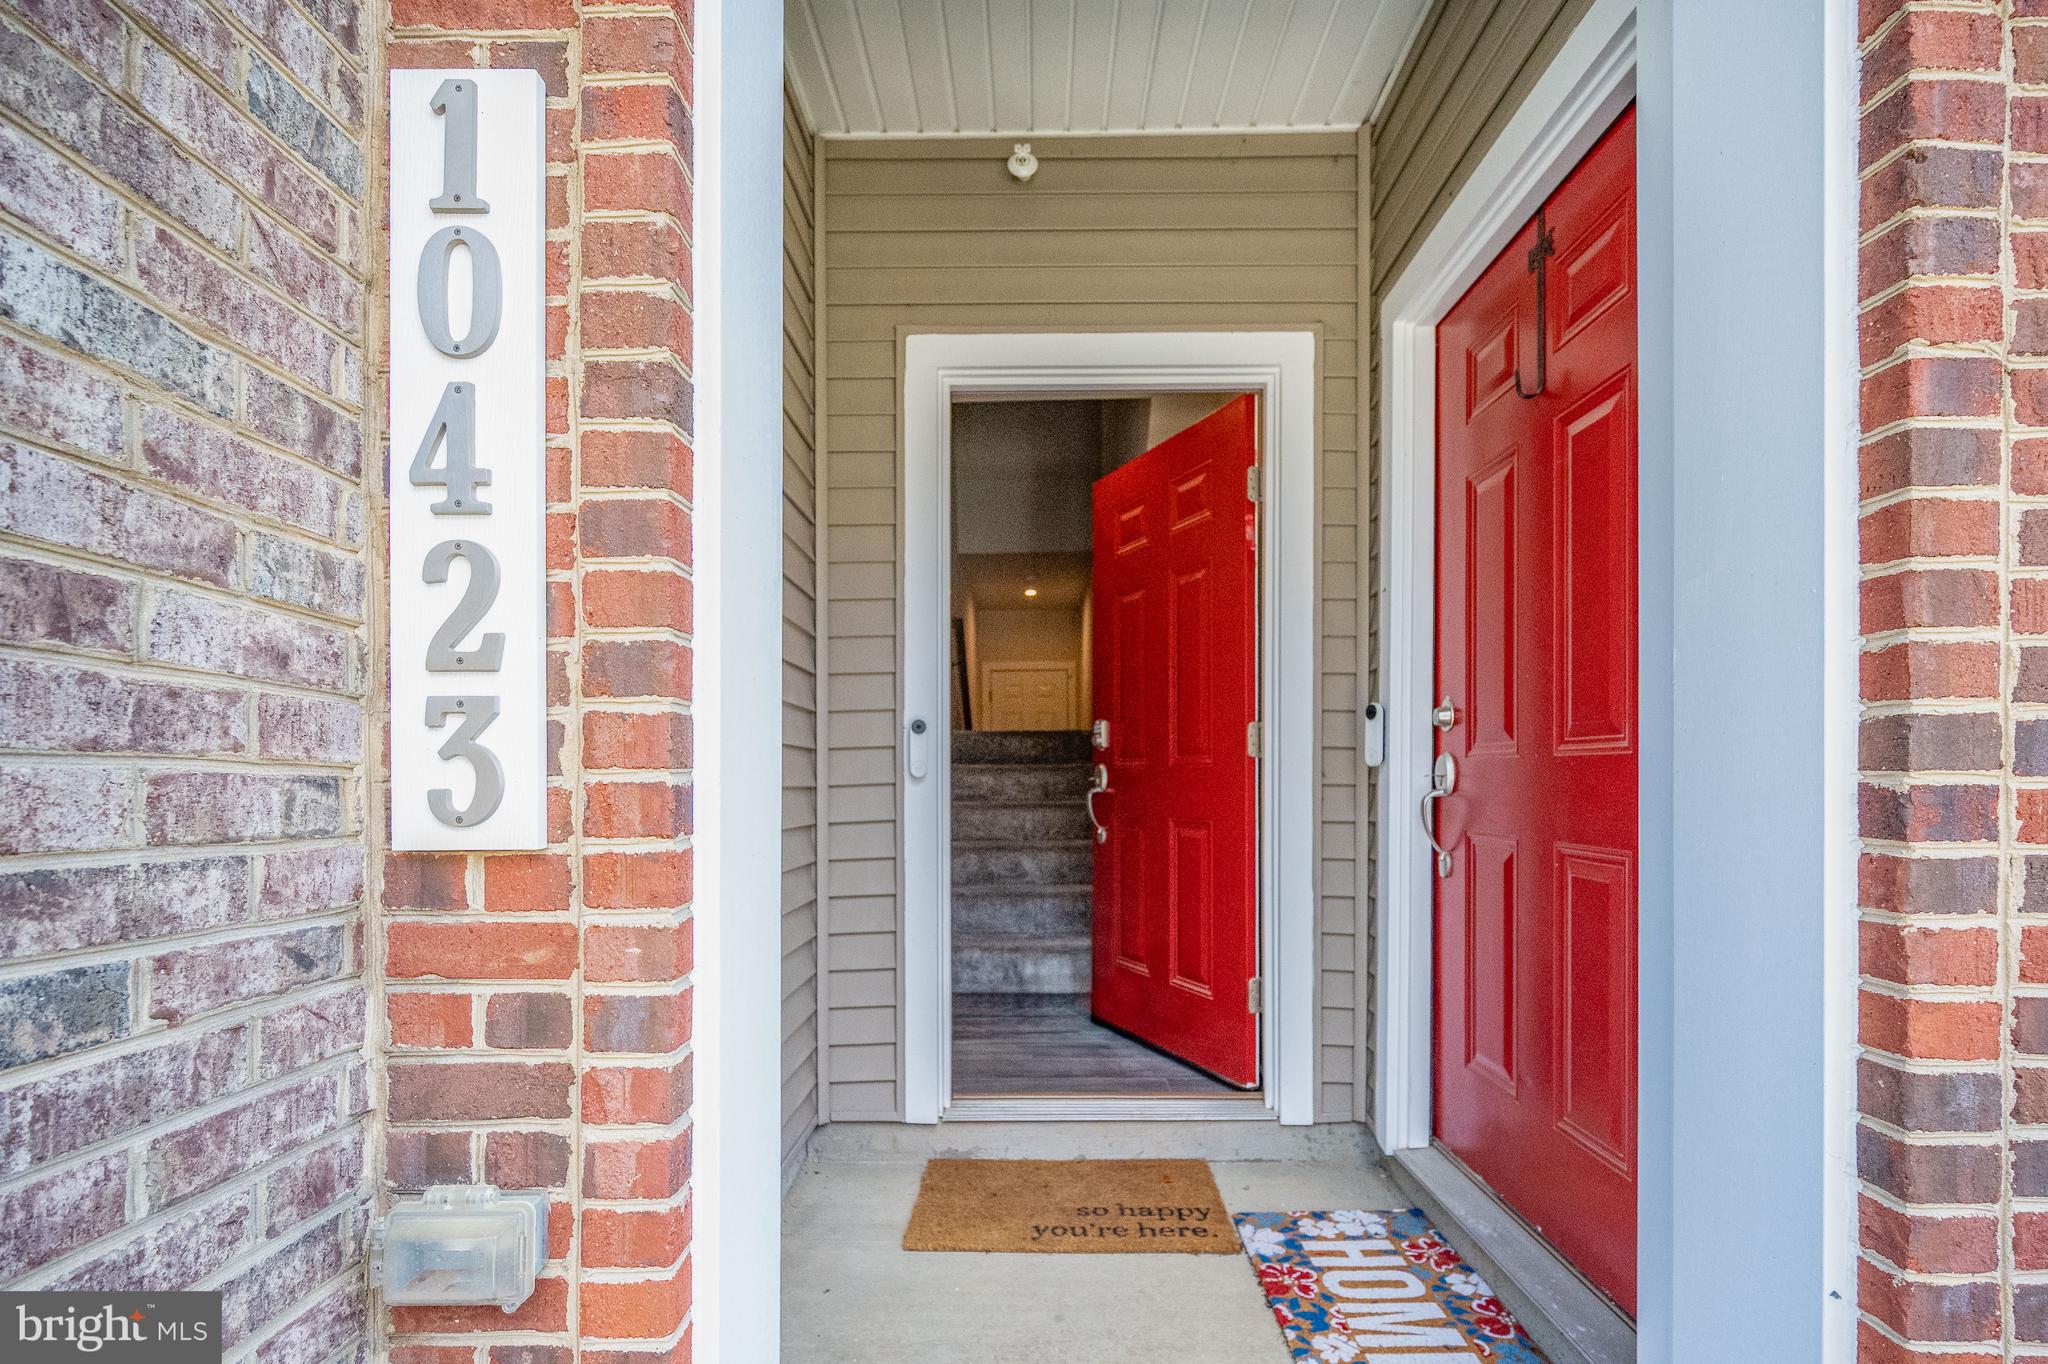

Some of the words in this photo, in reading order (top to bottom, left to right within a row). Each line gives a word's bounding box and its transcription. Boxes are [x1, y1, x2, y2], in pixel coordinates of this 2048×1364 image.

[409, 78, 506, 828] 10423
[1076, 1205, 1109, 1217] so
[1117, 1203, 1211, 1221] happy
[1030, 1222, 1128, 1240] you're
[1138, 1222, 1219, 1237] here.
